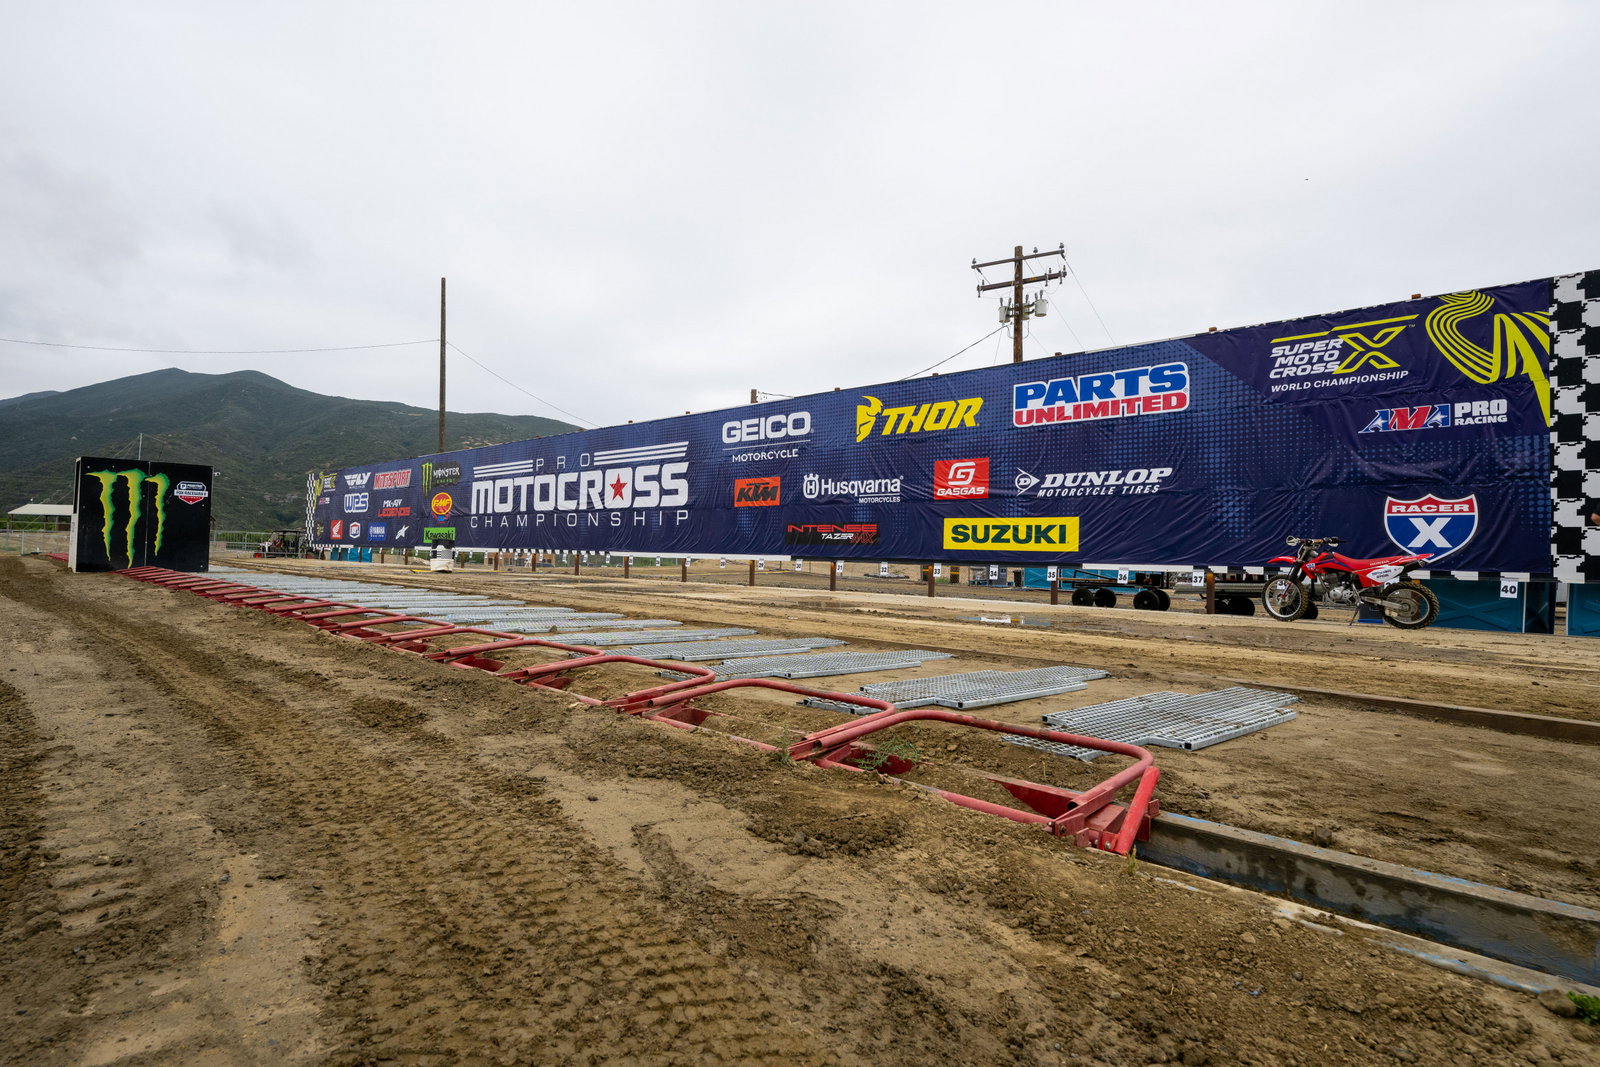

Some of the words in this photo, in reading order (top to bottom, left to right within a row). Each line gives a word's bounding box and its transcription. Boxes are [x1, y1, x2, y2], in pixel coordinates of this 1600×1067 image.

[1270, 338, 1344, 357] SUPER
[1274, 350, 1340, 367] MOTO
[1269, 361, 1341, 379] CROSS
[1014, 363, 1188, 410] PARTS
[1271, 381, 1311, 392] WORLD
[1313, 370, 1408, 388] CHAMPIONSHIP
[881, 397, 984, 435] THOR
[1014, 391, 1188, 425] UNLIMITED
[1358, 403, 1450, 433] AMA
[1454, 399, 1507, 418] PRO
[722, 411, 811, 444] GEICO
[1454, 415, 1507, 426] RACING
[536, 453, 591, 472] PRO
[732, 448, 799, 463] MOTORCYCLE
[433, 467, 460, 478] MONSTER
[1040, 467, 1173, 488] DUNLOP
[470, 462, 689, 514] MOTOCROSS
[737, 482, 779, 503] KTM
[821, 477, 900, 497] Husqvarna
[936, 486, 985, 496] GASGAS
[1037, 486, 1114, 498] MOTORCYCLE
[1122, 484, 1160, 494] TIRES
[1391, 502, 1470, 513] RACER
[470, 509, 689, 528] CHAMPIONSHIP
[425, 530, 454, 541] Kawasaki
[951, 524, 1067, 545] SUZUKI
[1407, 517, 1452, 548] X
[1118, 573, 1127, 581] 36
[1193, 575, 1203, 583] 37
[1501, 587, 1517, 595] 40
